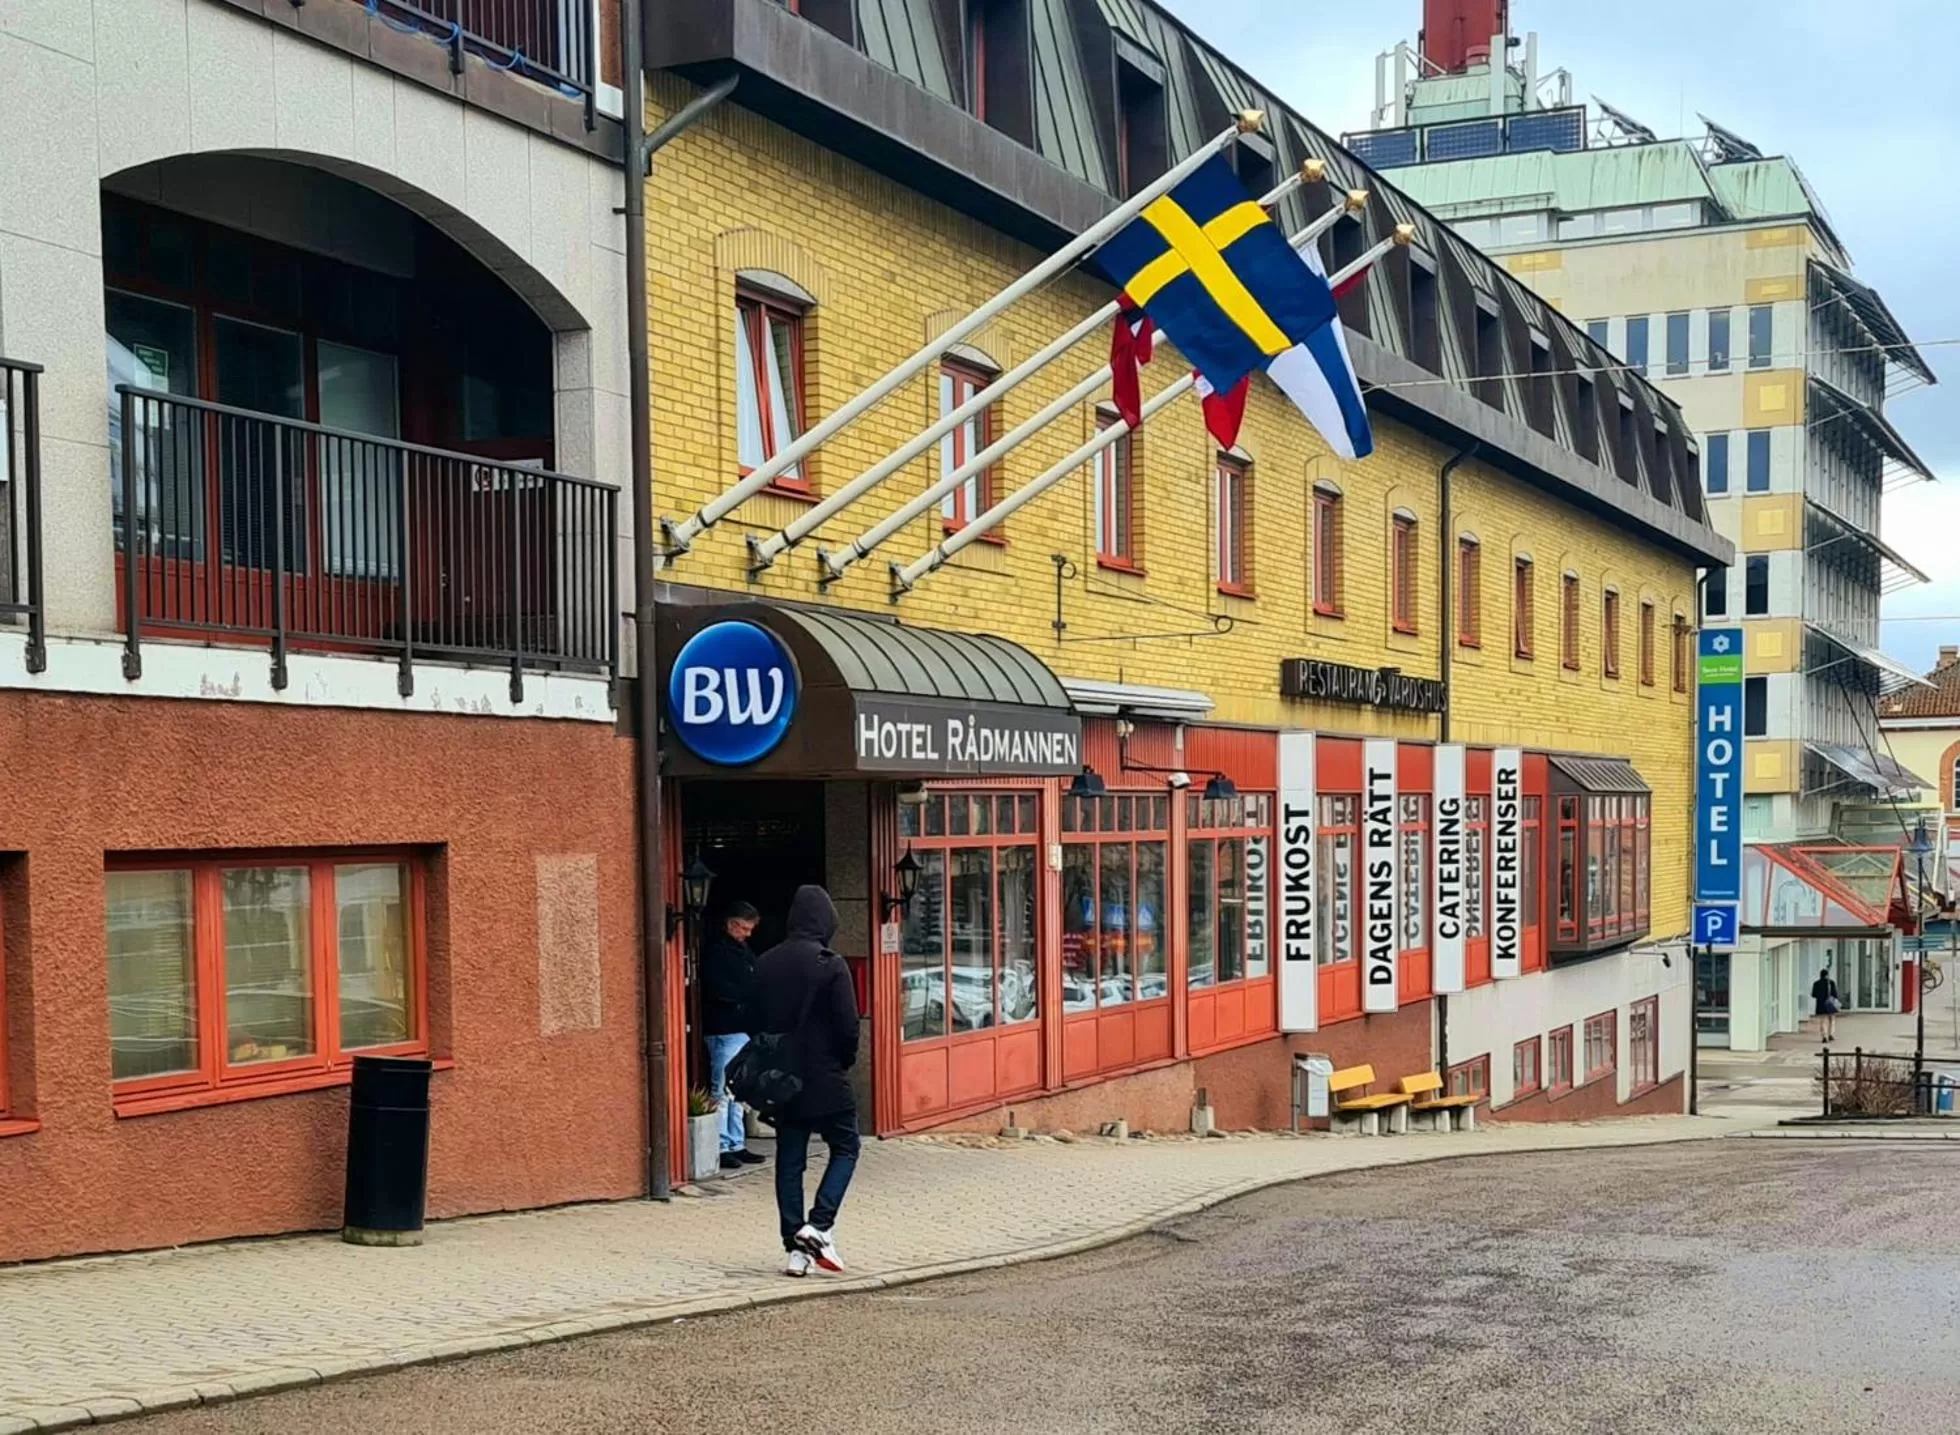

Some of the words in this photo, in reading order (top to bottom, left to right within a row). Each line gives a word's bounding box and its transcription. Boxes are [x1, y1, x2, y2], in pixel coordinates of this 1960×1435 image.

[684, 666, 784, 725] BW
[1299, 659, 1382, 704] RESTAURANG
[1363, 767, 1393, 848] RÄTT
[1706, 705, 1733, 866] HOTEL
[1284, 803, 1311, 962] FRUKOST
[1369, 860, 1393, 985] DAGENS
[1439, 797, 1460, 939] CATERING
[1496, 767, 1518, 960] KONFERENSER
